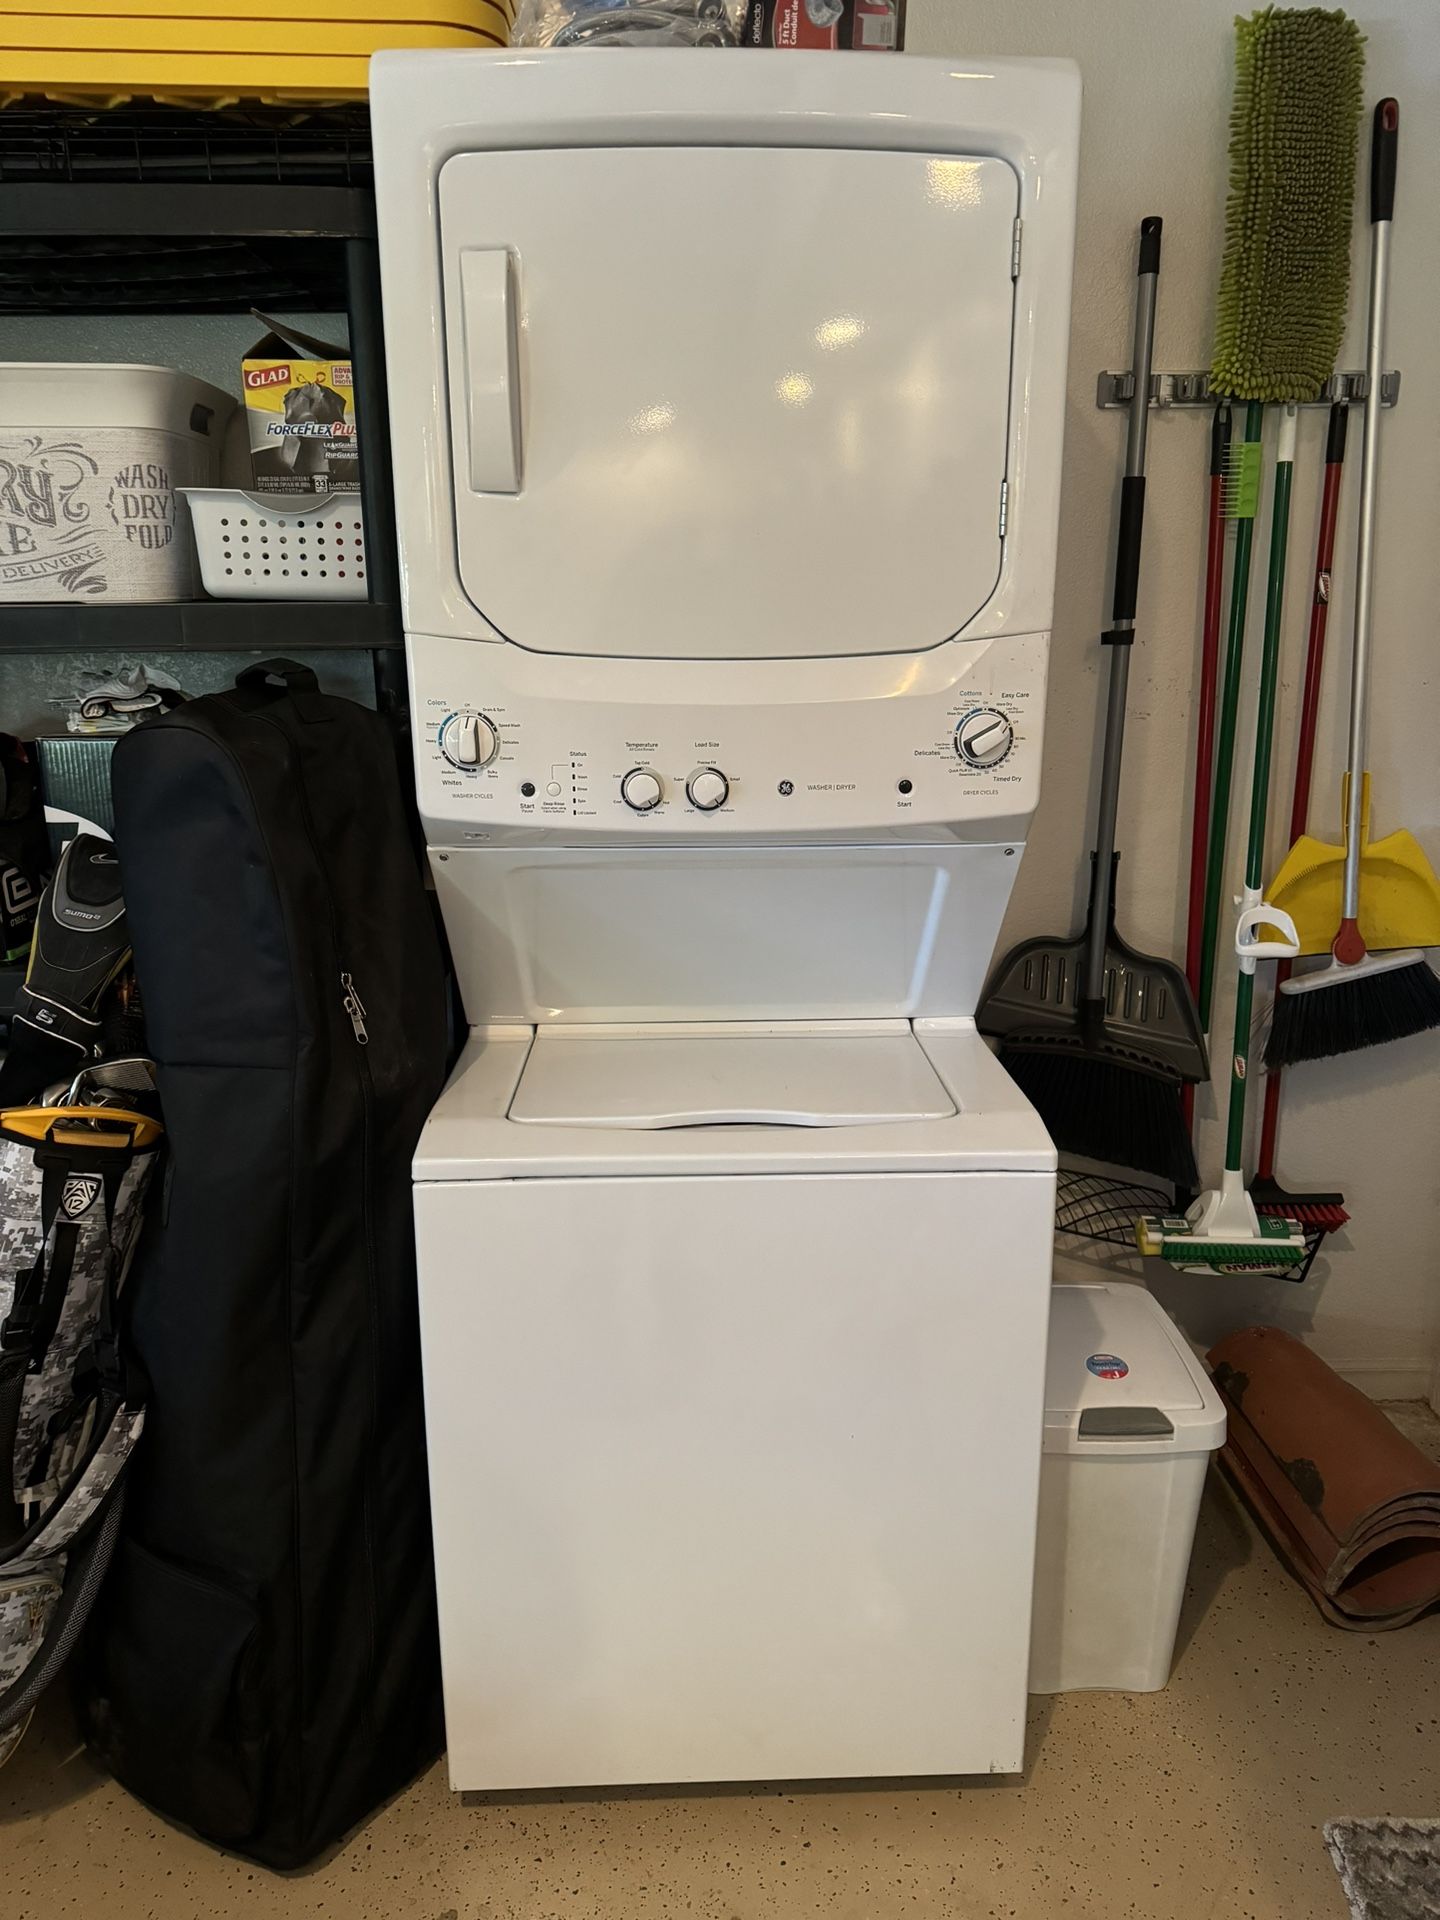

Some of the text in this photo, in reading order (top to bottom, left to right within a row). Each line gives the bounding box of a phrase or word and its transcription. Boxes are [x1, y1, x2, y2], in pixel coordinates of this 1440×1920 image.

[752, 3, 762, 44] deflecto
[782, 30, 790, 38] ft
[790, 12, 798, 45] Conduit
[247, 368, 289, 387] GLAD
[114, 464, 169, 490] WASH
[315, 480, 326, 488] 33
[122, 494, 169, 520] DRY
[125, 525, 172, 550] FOLD
[3, 549, 93, 579] DELIVERY
[63, 1181, 97, 1200] PAC
[68, 1198, 84, 1210] 12
